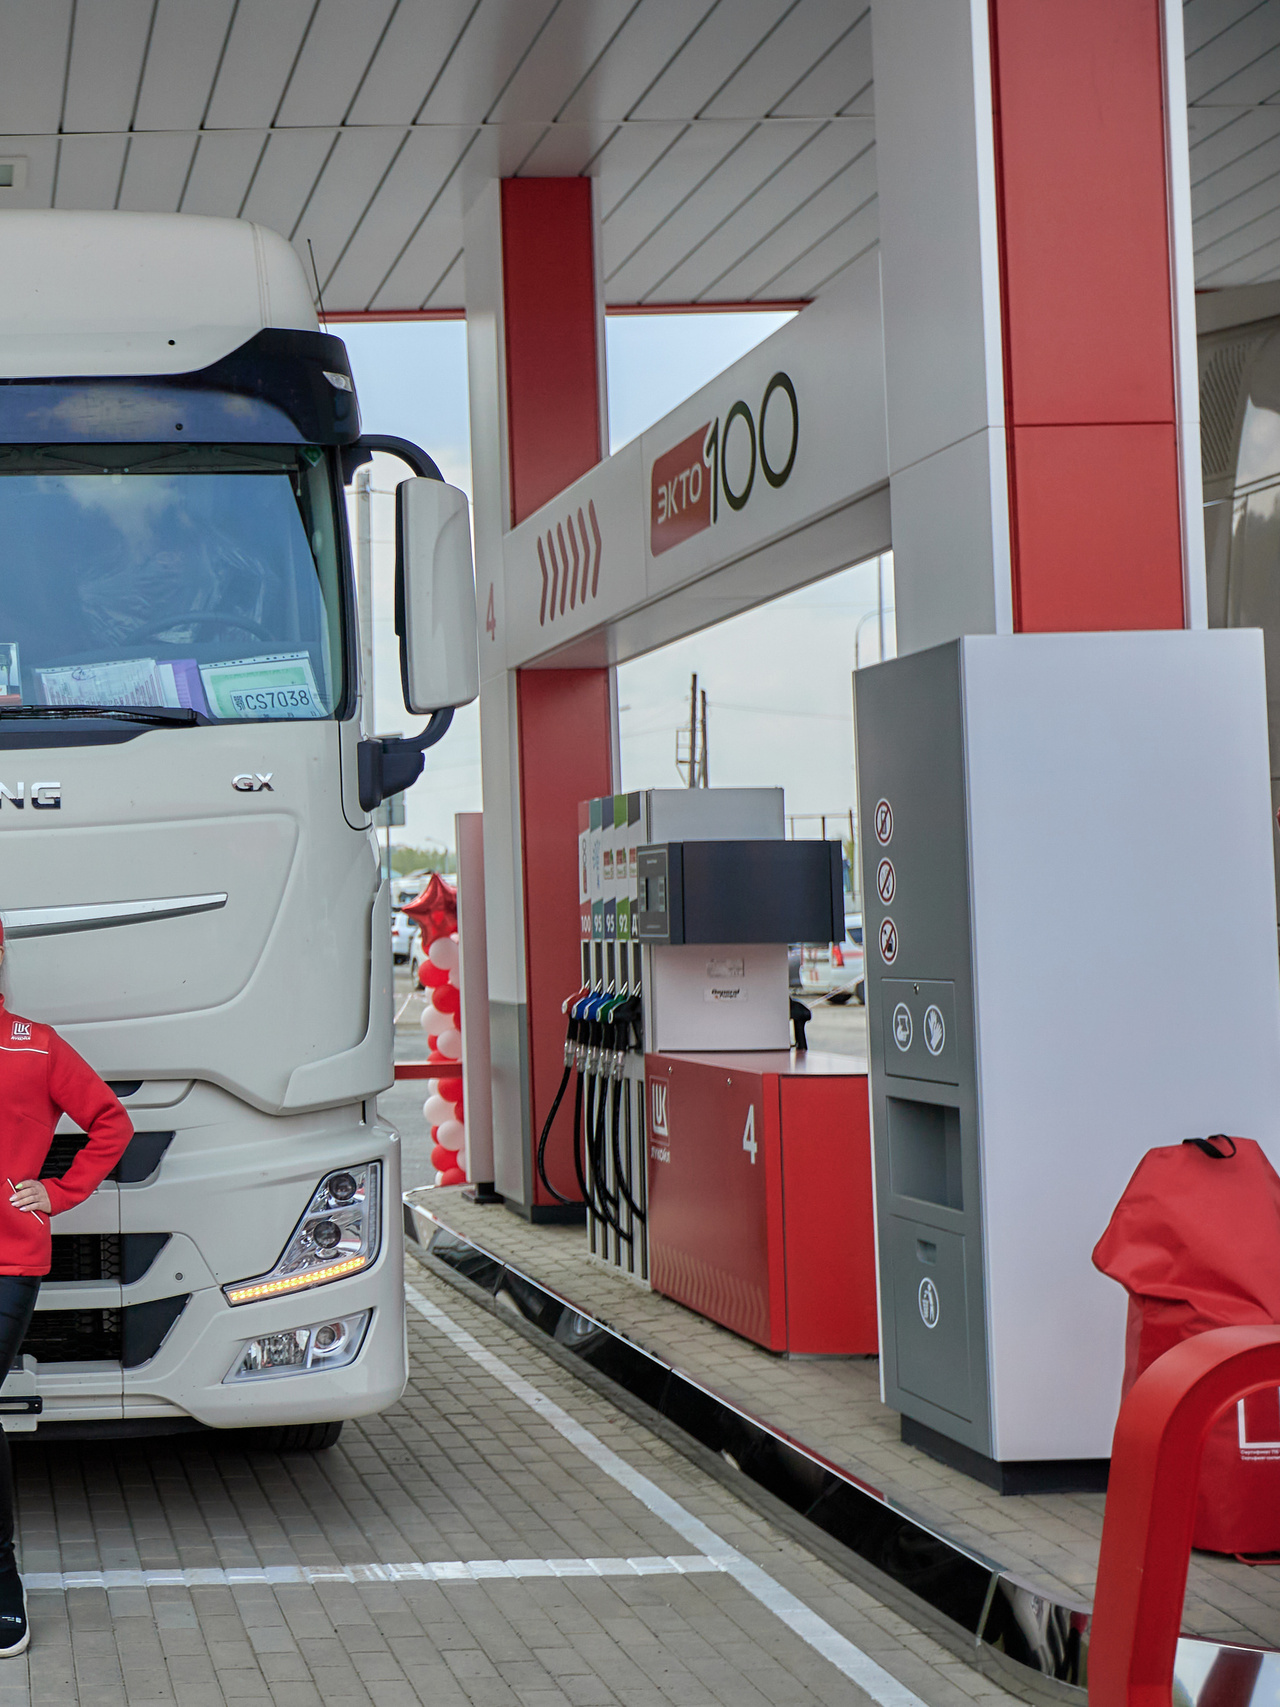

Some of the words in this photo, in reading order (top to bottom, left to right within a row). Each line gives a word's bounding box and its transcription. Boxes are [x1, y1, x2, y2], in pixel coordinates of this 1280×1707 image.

[657, 463, 702, 524] ЭКТО
[704, 371, 799, 525] 100
[486, 581, 497, 642] 4
[231, 772, 274, 793] GX
[581, 915, 592, 934] 100
[593, 914, 603, 933] 95
[606, 913, 615, 933] 95
[618, 913, 628, 933] 92
[742, 1103, 758, 1165] 4
